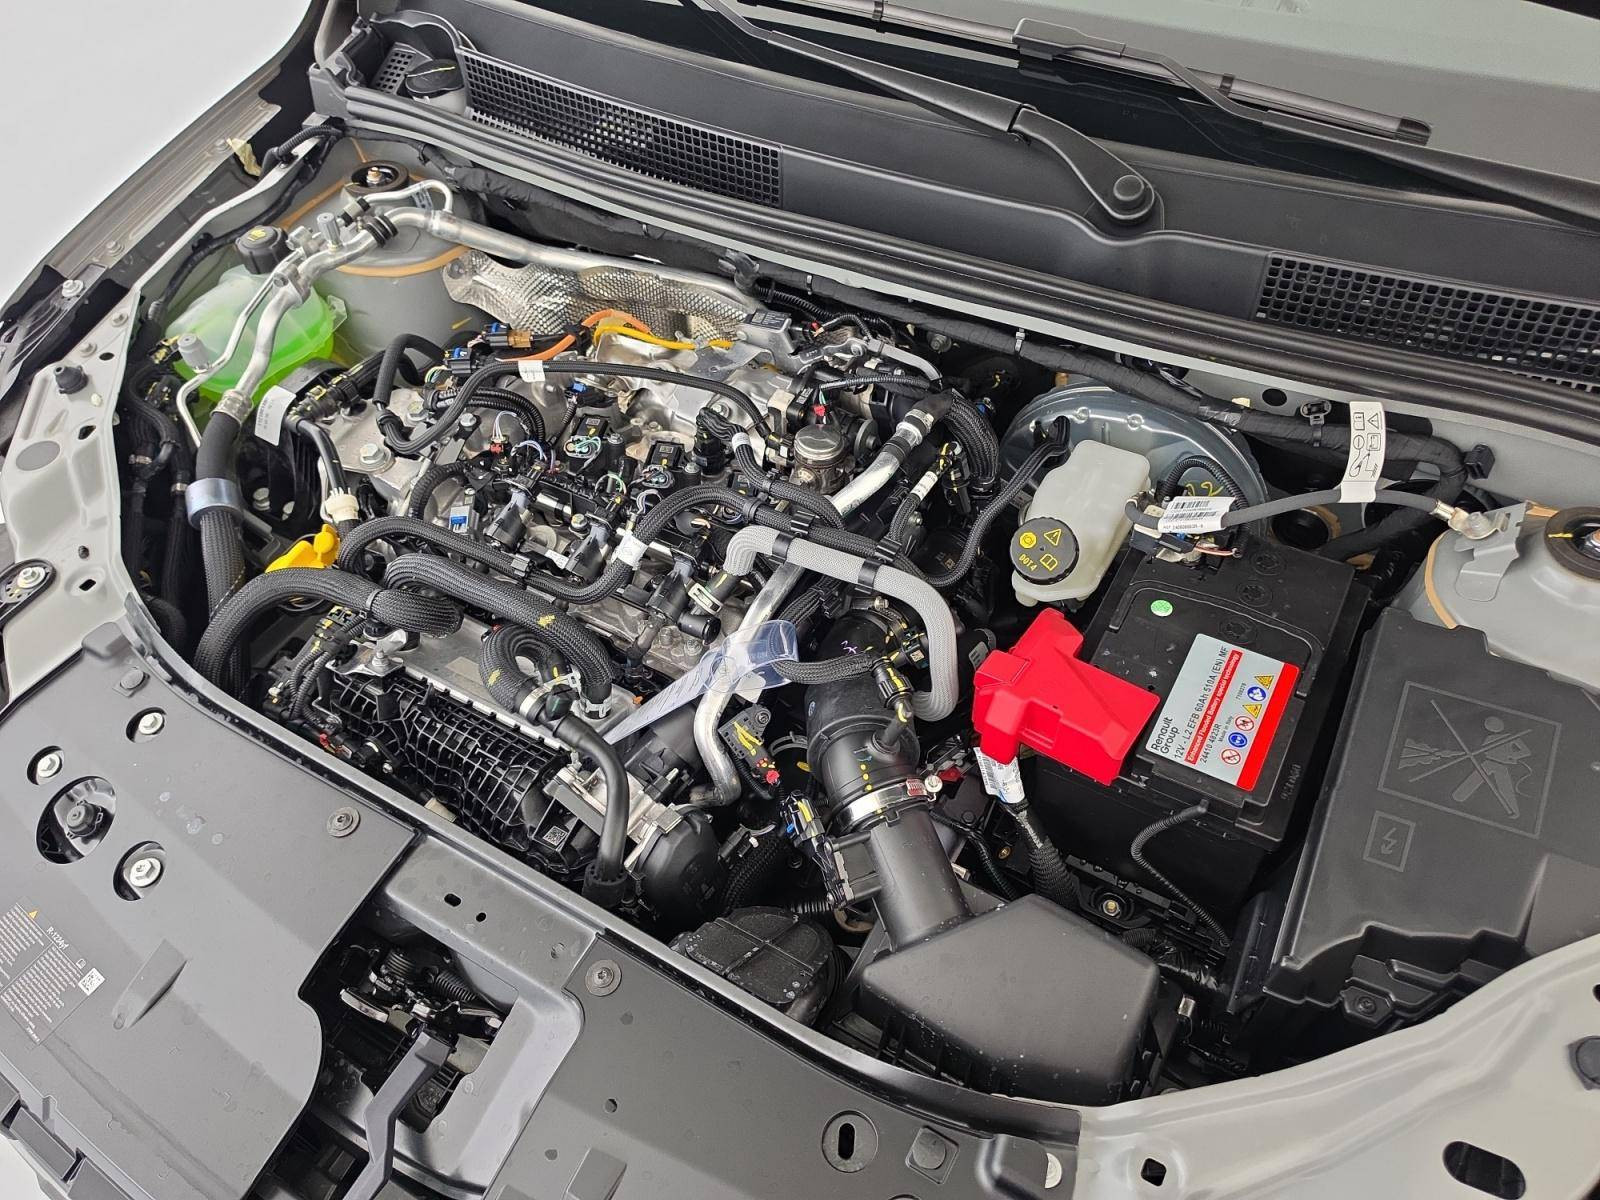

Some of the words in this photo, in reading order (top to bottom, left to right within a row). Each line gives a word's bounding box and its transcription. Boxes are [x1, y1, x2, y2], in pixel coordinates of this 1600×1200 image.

[1218, 645, 1229, 658] MF
[1211, 658, 1225, 675] (EN)
[1203, 675, 1217, 693] 510A
[1194, 692, 1209, 712] 60Ah
[1187, 712, 1200, 729] EFB
[1187, 735, 1203, 761] Enhanced
[1198, 714, 1212, 736] Flooded
[1207, 697, 1221, 716] Battery
[1150, 716, 1173, 751] Renault
[1160, 726, 1180, 754] Group
[1183, 729, 1193, 740] L2
[1174, 744, 1185, 759] 12V
